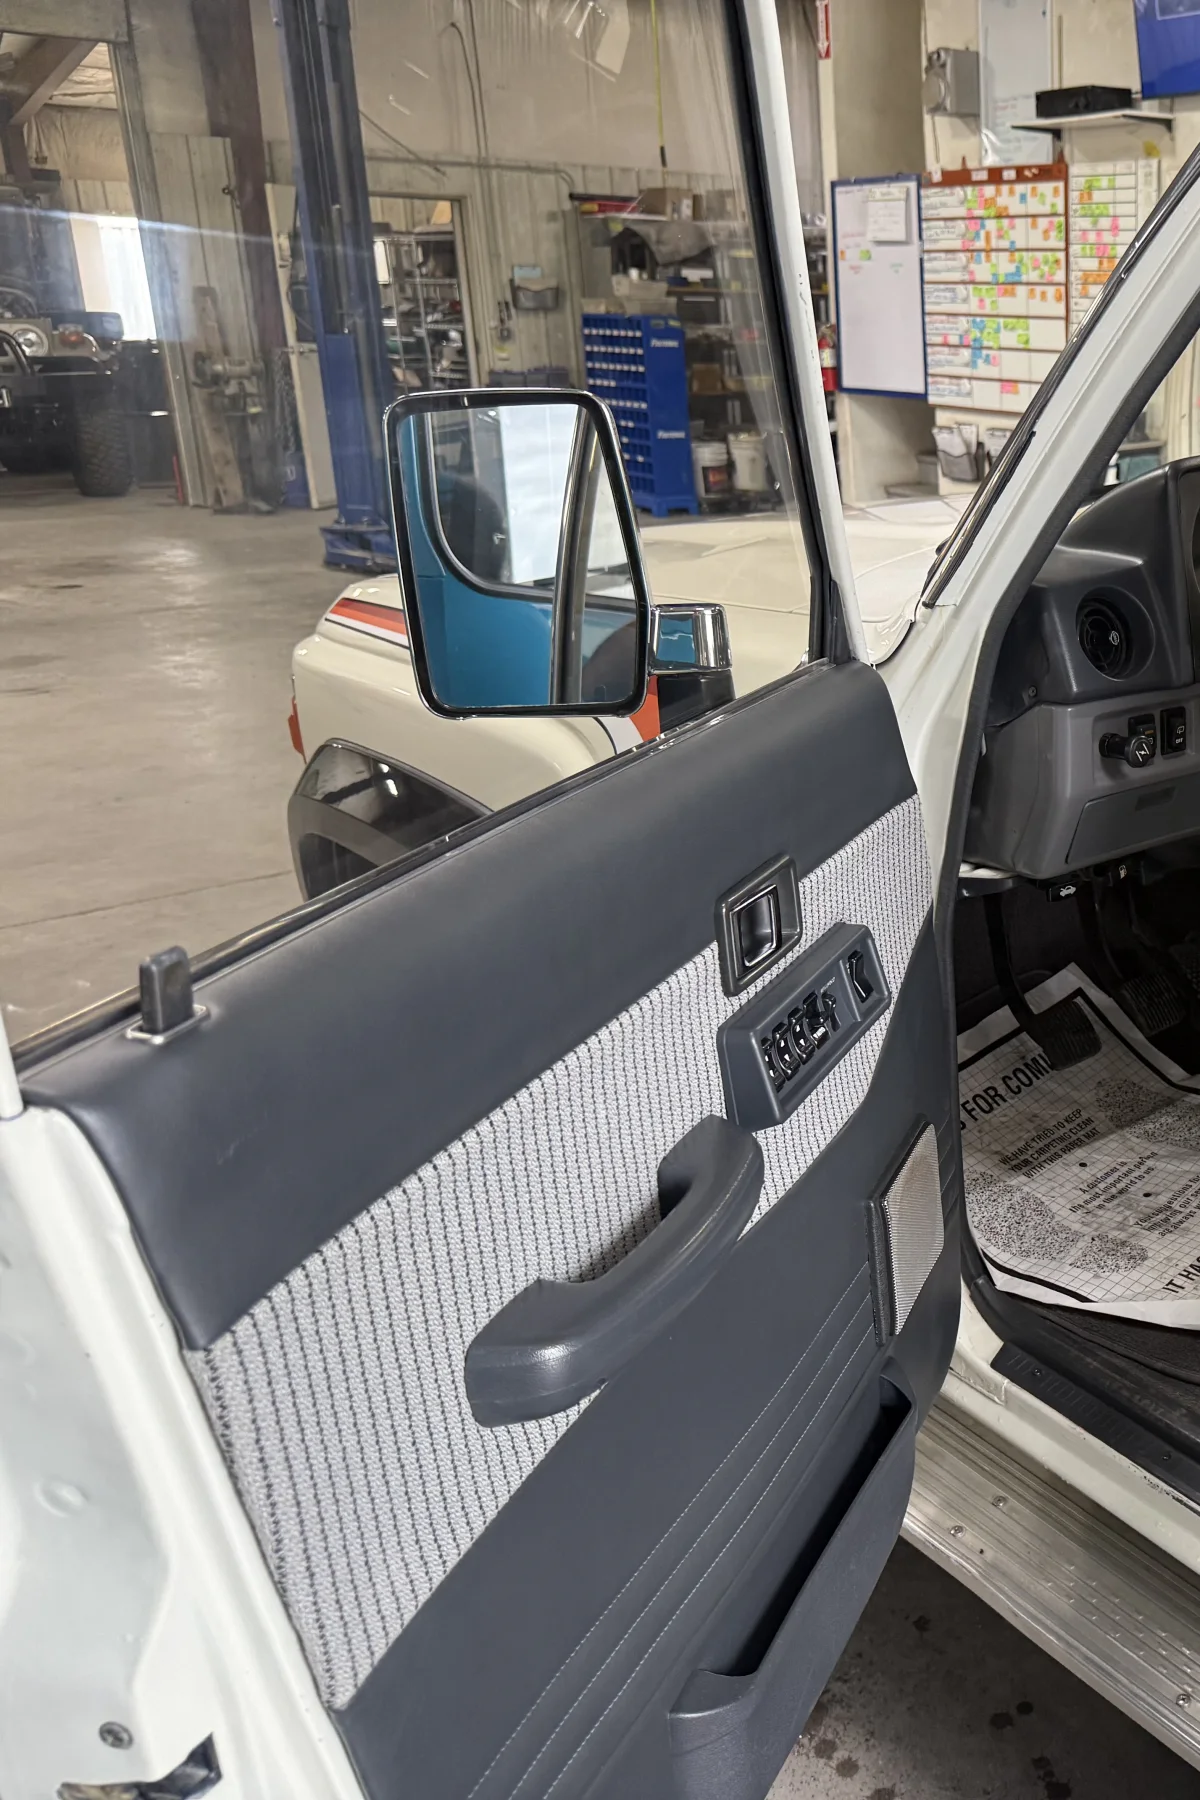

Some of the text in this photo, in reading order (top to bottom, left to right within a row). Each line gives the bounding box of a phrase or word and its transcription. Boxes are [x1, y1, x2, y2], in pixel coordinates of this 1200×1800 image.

[961, 1086, 1007, 1121] FOR
[999, 1108, 1082, 1166] WE HAVE TRIED TO KEEP
[1008, 1116, 1095, 1173] YOUR CARPETING CLEAN
[1022, 1127, 1101, 1179] WITH THIS PAPER MAT
[1068, 1151, 1158, 1213] the most important person
[1086, 1166, 1120, 1190] customer
[1102, 1194, 1118, 1204] the
[1117, 1179, 1138, 1195] world
[1146, 1209, 1182, 1232] improving
[1179, 1197, 1193, 1208] our
[1152, 1184, 1193, 1217] suggestions
[1158, 1228, 1173, 1237] are
[1171, 1209, 1197, 1230] always
[1162, 1278, 1186, 1294] IT
